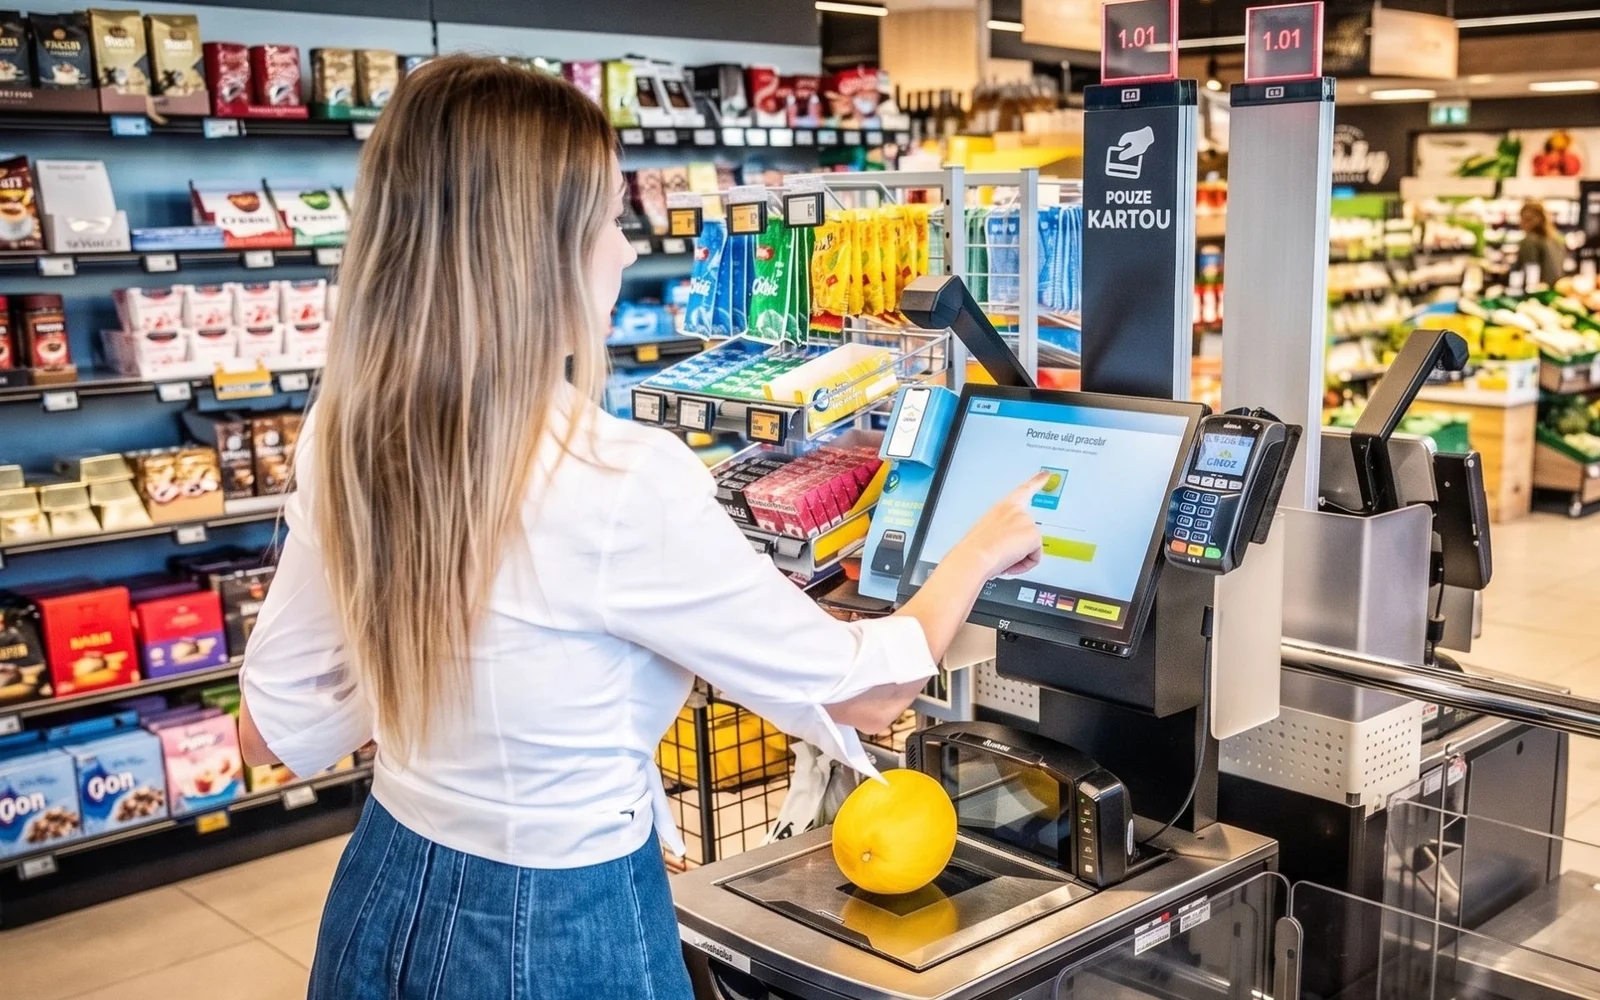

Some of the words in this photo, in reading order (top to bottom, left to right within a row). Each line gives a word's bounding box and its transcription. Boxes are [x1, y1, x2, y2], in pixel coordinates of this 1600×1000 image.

[1118, 26, 1155, 49] 1.01
[1262, 28, 1301, 51] 1.01
[1106, 190, 1152, 205] POUZE
[1087, 209, 1171, 229] KARTOU
